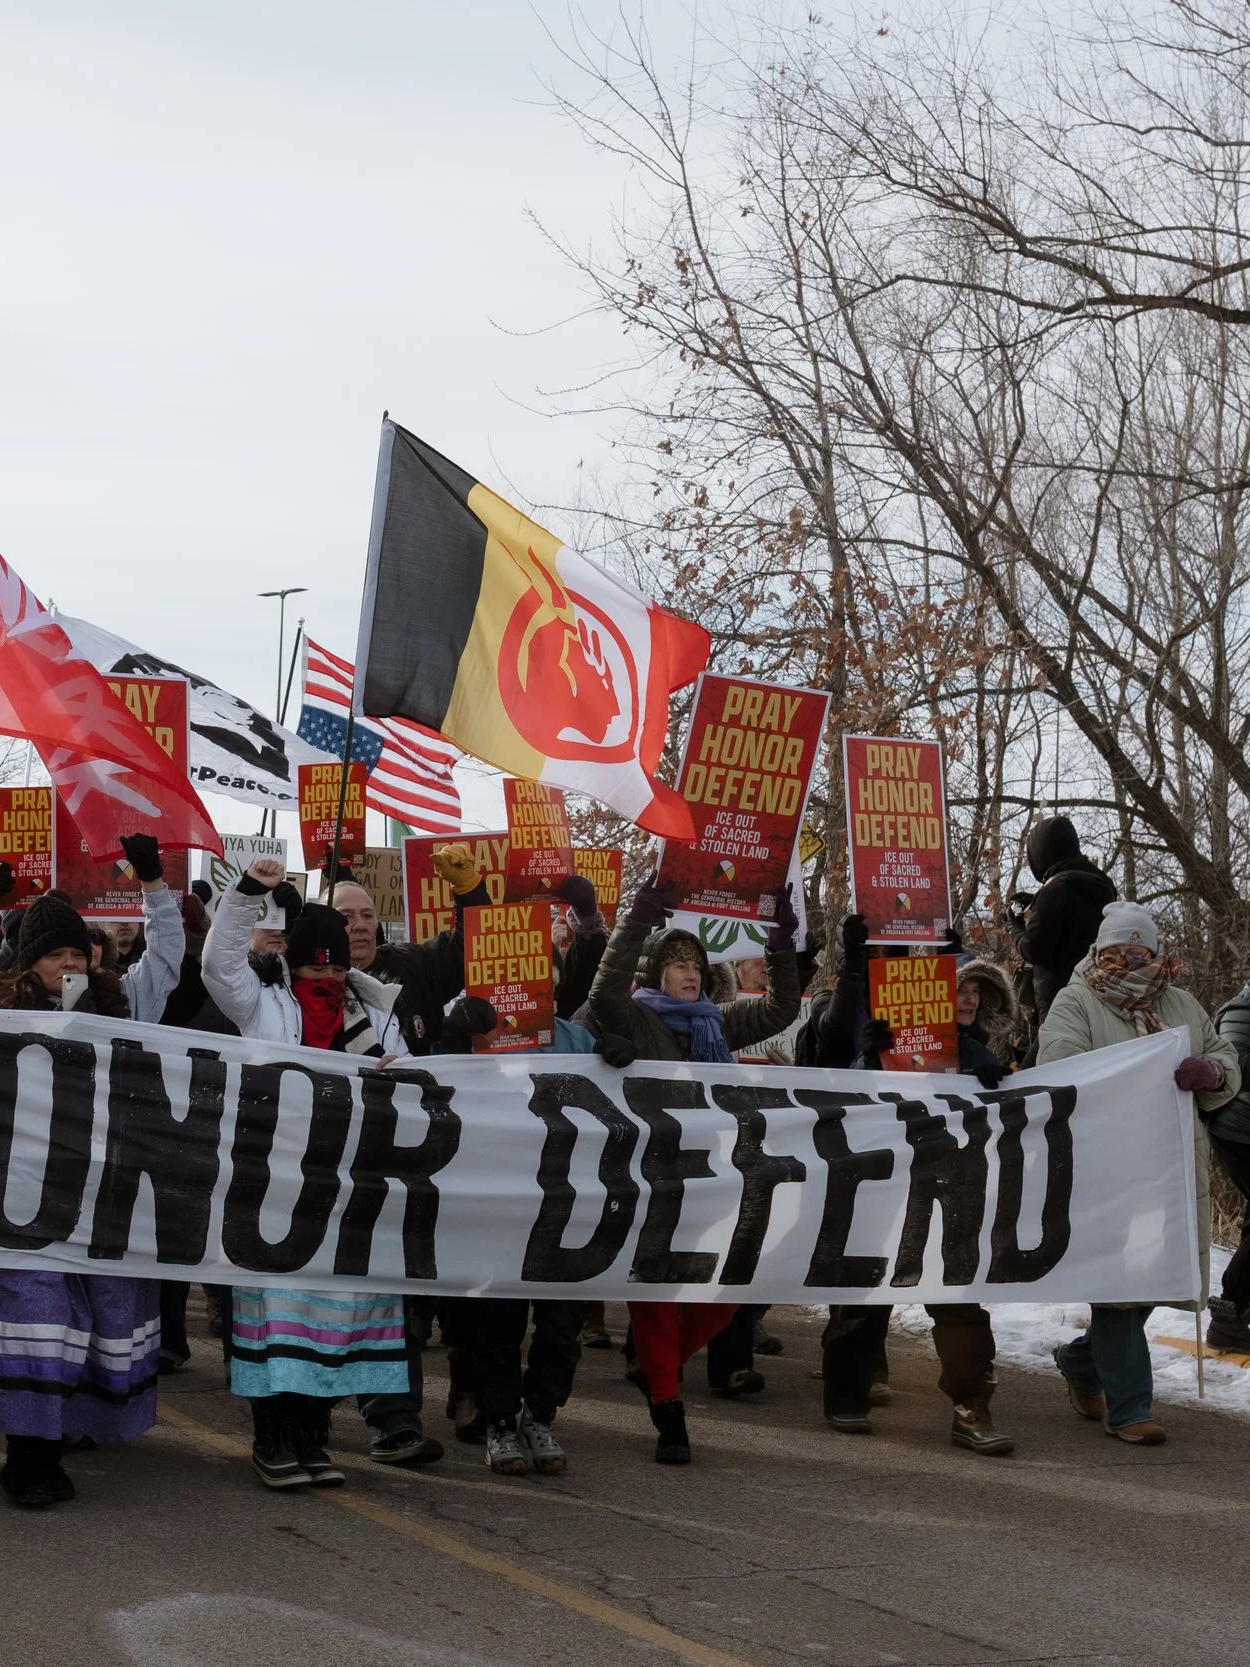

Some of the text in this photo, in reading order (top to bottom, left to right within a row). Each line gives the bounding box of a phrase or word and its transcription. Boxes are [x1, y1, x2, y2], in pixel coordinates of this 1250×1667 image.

[107, 682, 161, 722] AY
[721, 685, 803, 733] PRAY
[699, 723, 805, 776] HONOR
[866, 744, 922, 779] PRAY
[11, 789, 51, 810] PRA
[514, 781, 551, 802] PRAY
[683, 763, 802, 817] DEFEND
[858, 778, 934, 815] HONOR
[3, 810, 51, 831] HON
[301, 801, 364, 822] DEFEND
[511, 803, 564, 826] HONOR
[715, 811, 757, 829] ICE OUT
[510, 826, 570, 849] DEFEND
[704, 824, 761, 844] OF SACRED
[855, 813, 941, 849] DEFEND
[0, 831, 51, 853] DEFE
[250, 839, 283, 856] YUHA
[700, 839, 742, 857] STOLEN
[742, 844, 770, 860] LAND
[23, 853, 49, 862] ICE OUT
[528, 858, 561, 867] OF SACRED
[533, 850, 555, 859] ICE OUT
[574, 850, 611, 869] PRAY
[884, 852, 915, 863] ICE OUT
[18, 862, 28, 870] OF
[18, 869, 43, 877] STOLEN
[521, 866, 568, 876] & STOLEN LAND
[879, 863, 921, 876] OF SACRED
[871, 876, 931, 889] & STOLEN LAND
[379, 894, 406, 917] LAN
[479, 905, 533, 933] PRAY
[472, 930, 543, 960] HONOR
[468, 955, 549, 986] DEFEND
[885, 958, 939, 983] PRAY
[489, 993, 528, 1004] OF SACRED
[494, 984, 523, 995] ICE OUT
[877, 980, 949, 1006] HONOR
[493, 1001, 537, 1013] TOLEN LAND
[895, 1035, 934, 1046] OF SACRED
[900, 1027, 928, 1037] ICE OUT
[896, 1044, 923, 1054] STOLEN
[924, 1042, 943, 1051] LAND
[521, 1073, 1077, 1288] DEFEND
